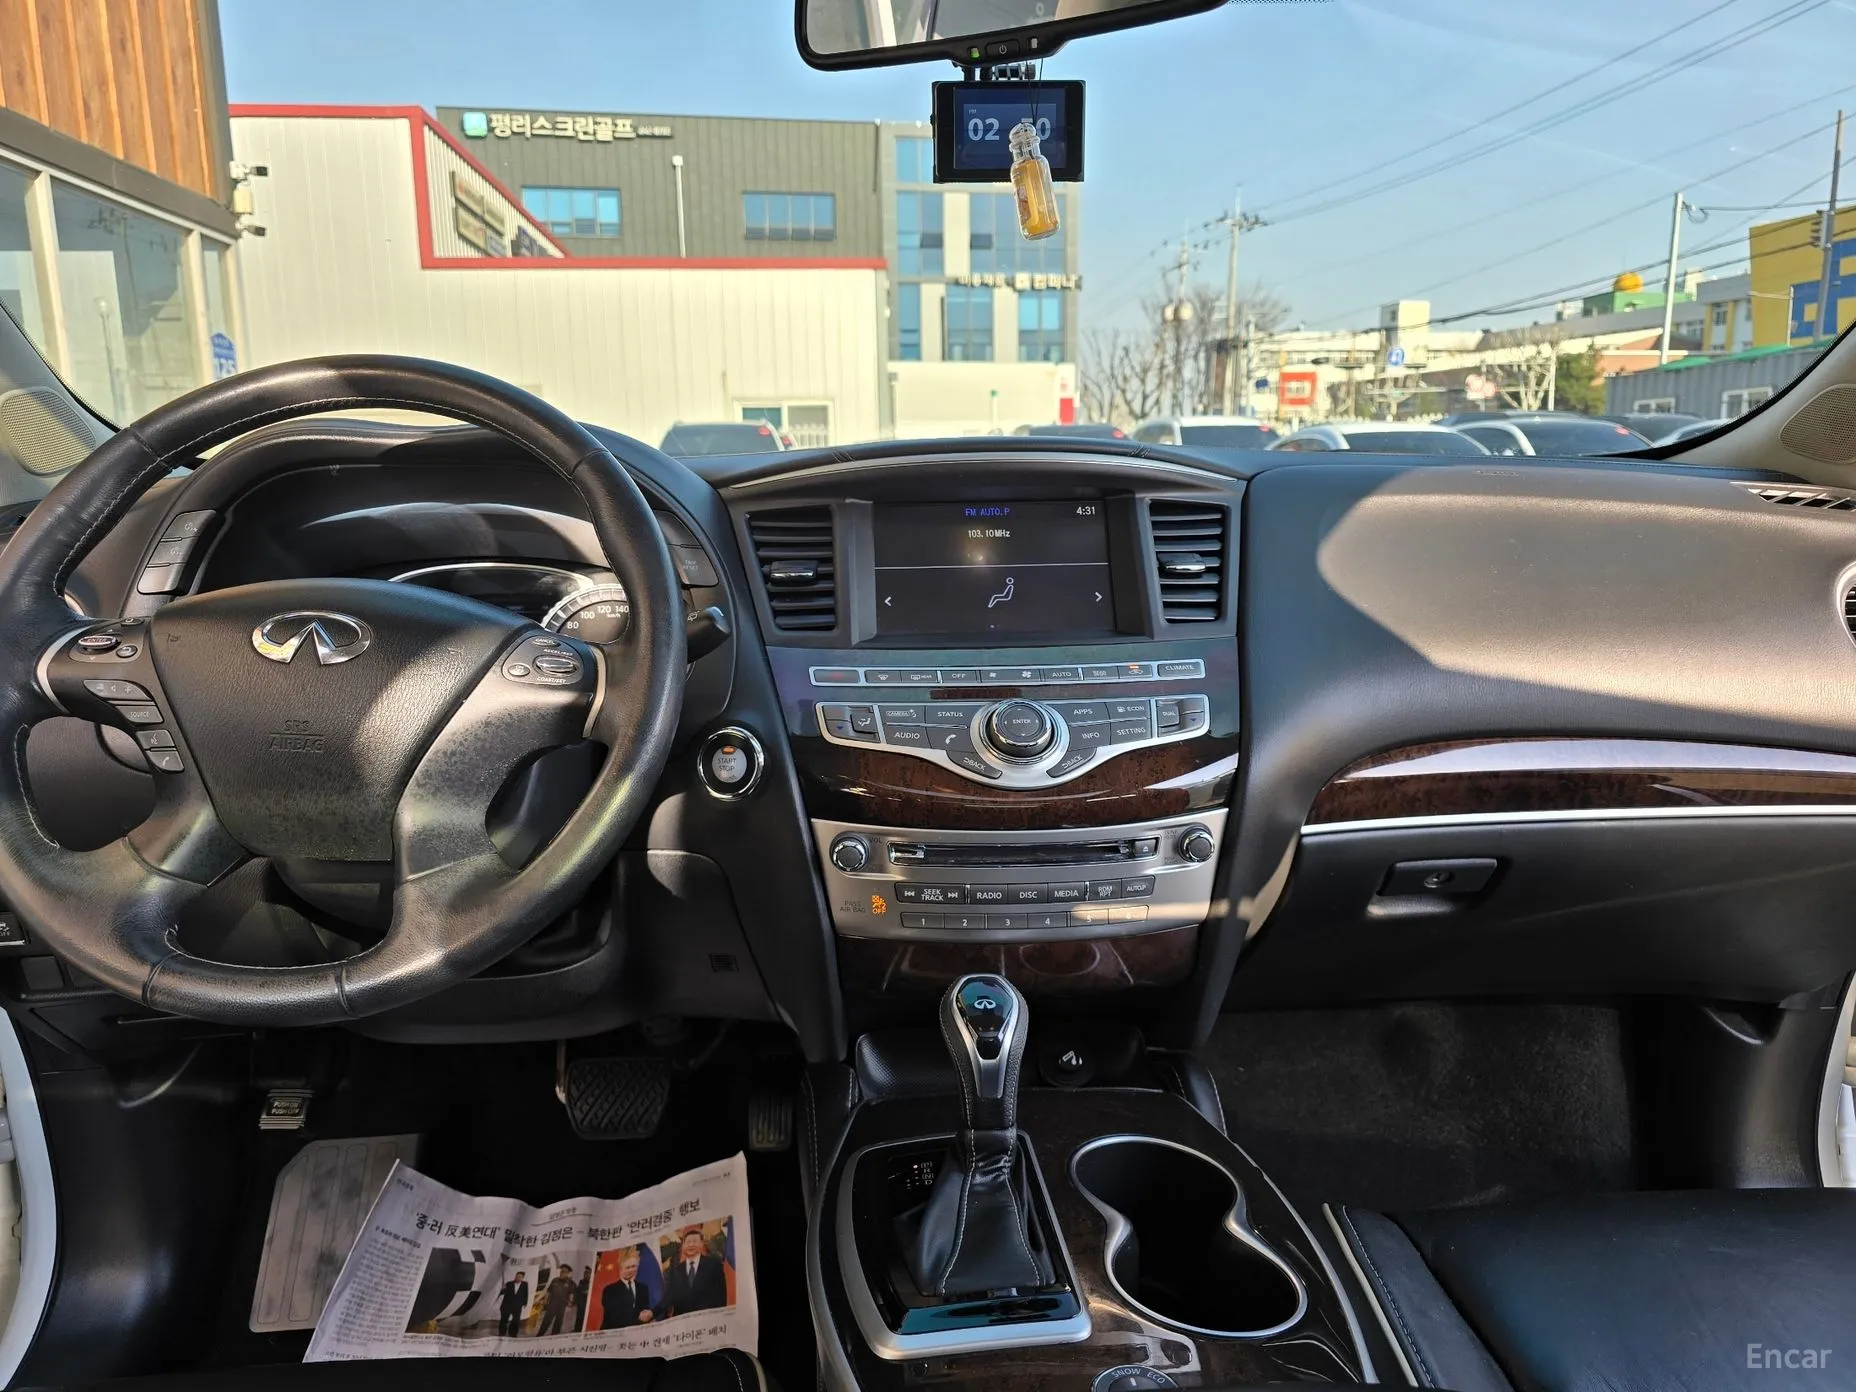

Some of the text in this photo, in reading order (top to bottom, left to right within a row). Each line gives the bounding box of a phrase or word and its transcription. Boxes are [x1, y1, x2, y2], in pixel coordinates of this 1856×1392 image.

[968, 117, 1051, 141] 02 0
[965, 507, 1010, 517] FM AUTO.P
[1076, 506, 1096, 516] 4:31
[566, 605, 630, 630] 80 100 120 140
[1165, 663, 1195, 672] CLIMATE
[1073, 708, 1094, 716] APPS
[1127, 705, 1145, 713] ECON
[893, 732, 921, 740] AUDIO
[1081, 731, 1101, 740] INFO
[1116, 727, 1146, 736] SETTING
[968, 758, 987, 771] BACK
[976, 891, 1002, 899] RADIO
[1019, 891, 1038, 899] DISC
[1054, 889, 1079, 898] MEDIA
[540, 1226, 574, 1245] 김정은
[588, 1226, 623, 1241] 북한판
[679, 1199, 701, 1217] 행보
[1111, 1368, 1166, 1384] SNOW ECO
